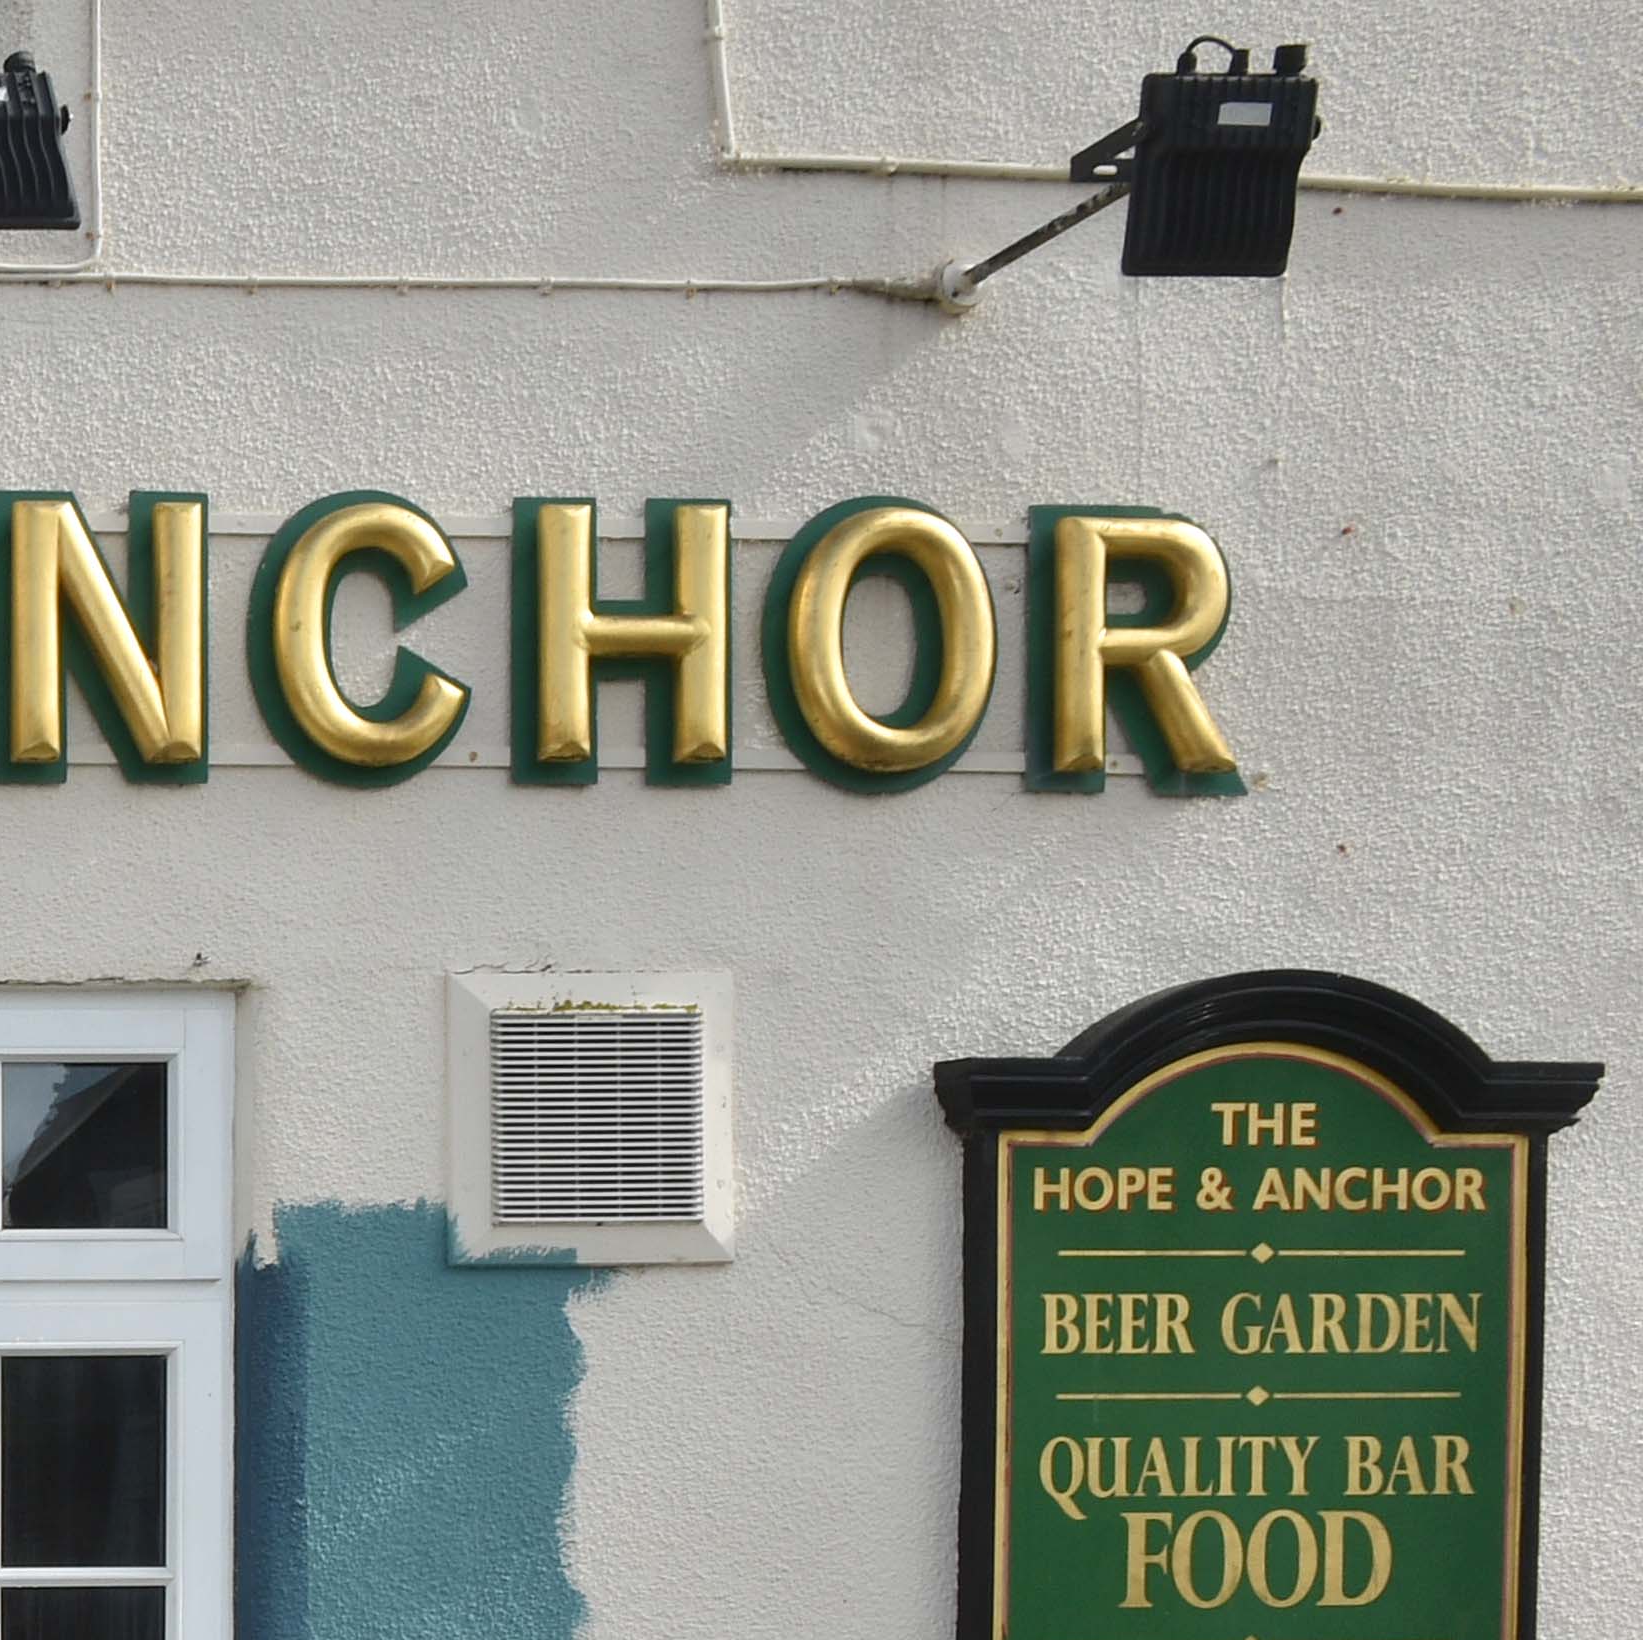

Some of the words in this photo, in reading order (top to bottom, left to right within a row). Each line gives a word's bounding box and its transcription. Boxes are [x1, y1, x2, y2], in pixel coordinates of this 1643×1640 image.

[1211, 1101, 1321, 1147] THE
[1032, 1166, 1178, 1213] HOPE
[1195, 1166, 1235, 1212] &
[1252, 1166, 1487, 1213] ANCHOR
[1039, 1293, 1196, 1355] BEER
[1221, 1291, 1483, 1355] GARDEN
[1038, 1435, 1320, 1521] QUALITY
[1344, 1435, 1476, 1498] BAR
[1118, 1509, 1394, 1609] FOOD
